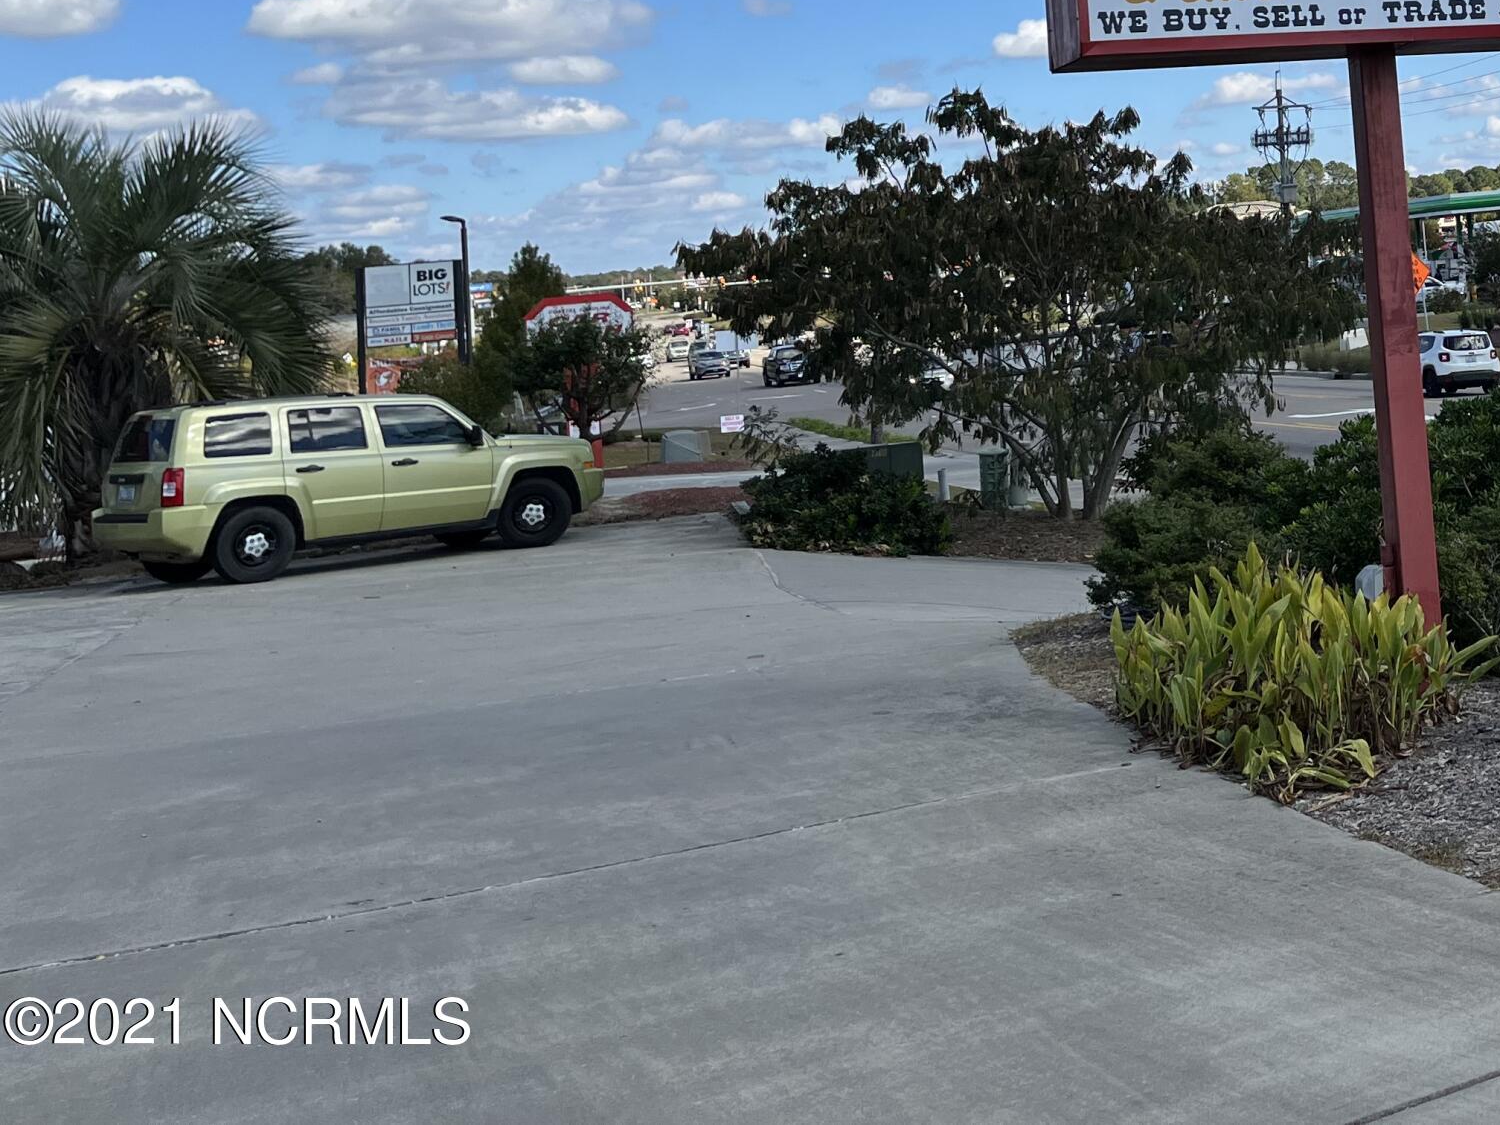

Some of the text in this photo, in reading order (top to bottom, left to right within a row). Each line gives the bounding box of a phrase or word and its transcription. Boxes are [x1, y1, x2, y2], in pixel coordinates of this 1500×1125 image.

[1097, 10, 1149, 34] WE
[1252, 4, 1326, 27] SELL
[1338, 7, 1367, 25] or
[416, 268, 448, 282] BIG
[413, 281, 451, 296] LOTS!
